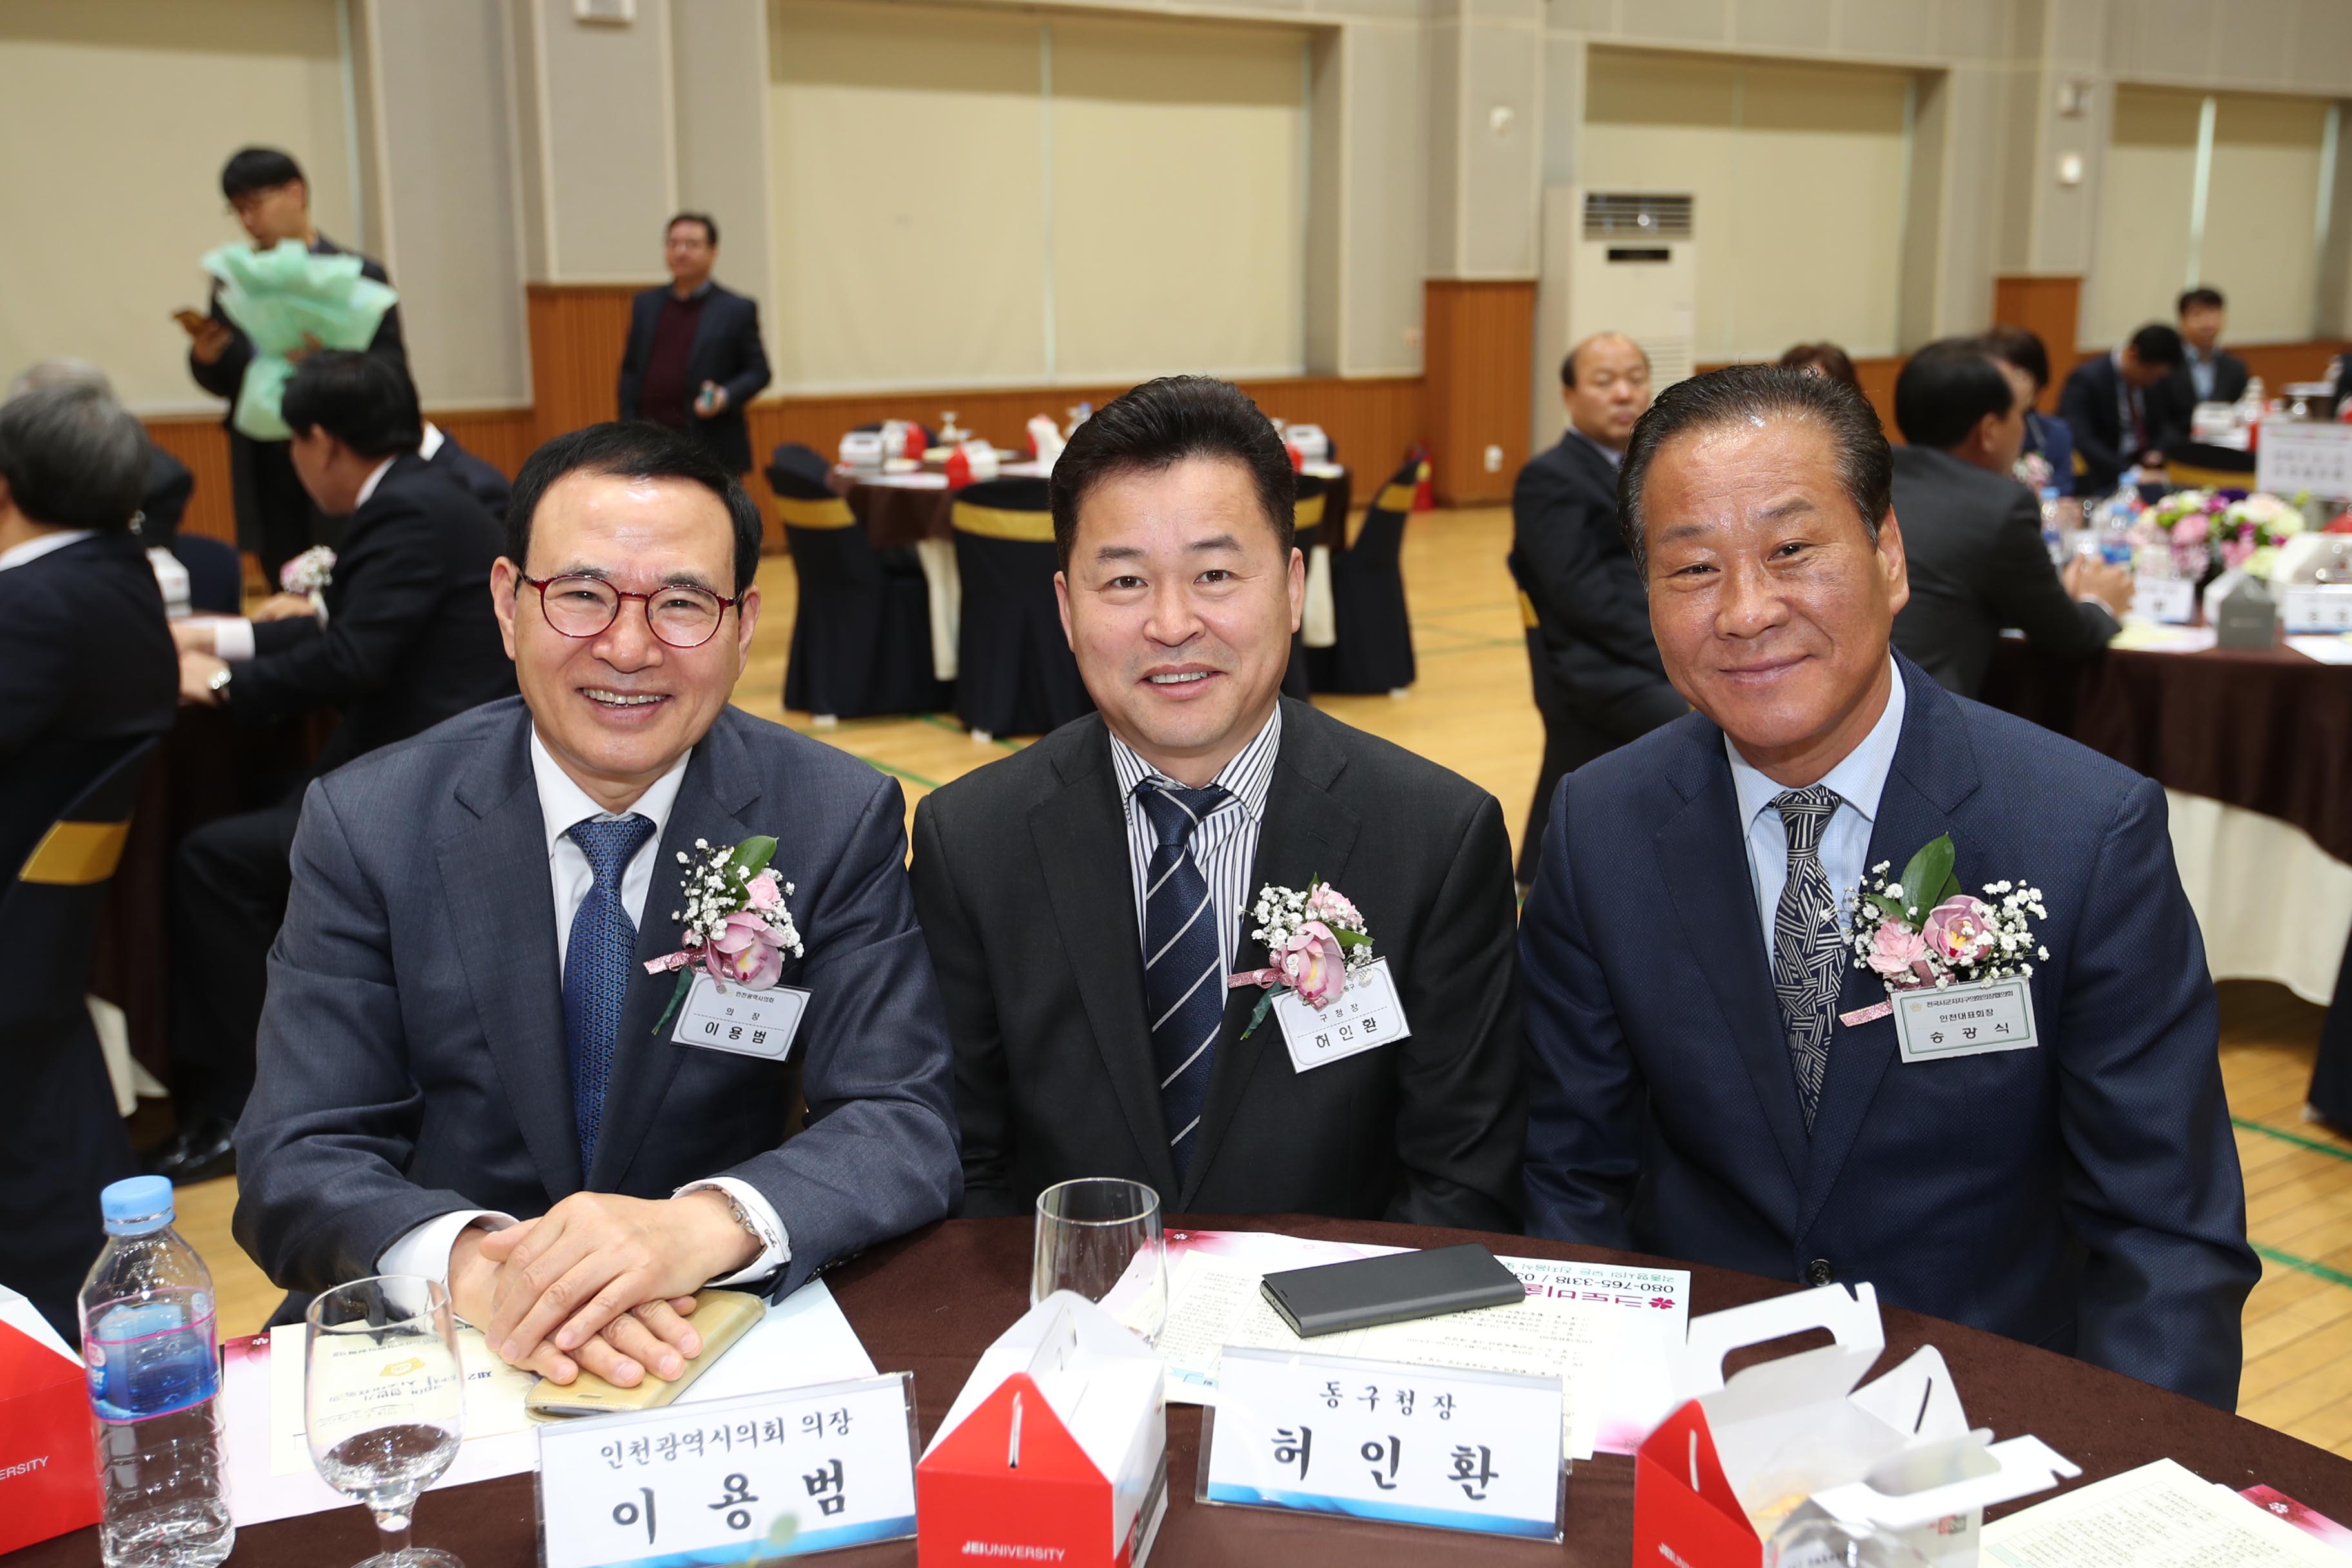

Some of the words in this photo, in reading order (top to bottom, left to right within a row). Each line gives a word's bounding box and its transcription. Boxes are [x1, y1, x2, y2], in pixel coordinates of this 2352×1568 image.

[736, 991, 775, 1003] 인천광역시의회
[1939, 1008, 1994, 1023] 인천대표회장
[1556, 1276, 1674, 1293] 080-765-3318
[600, 1417, 785, 1469] 인천광역시의회
[800, 1407, 854, 1441] 의장
